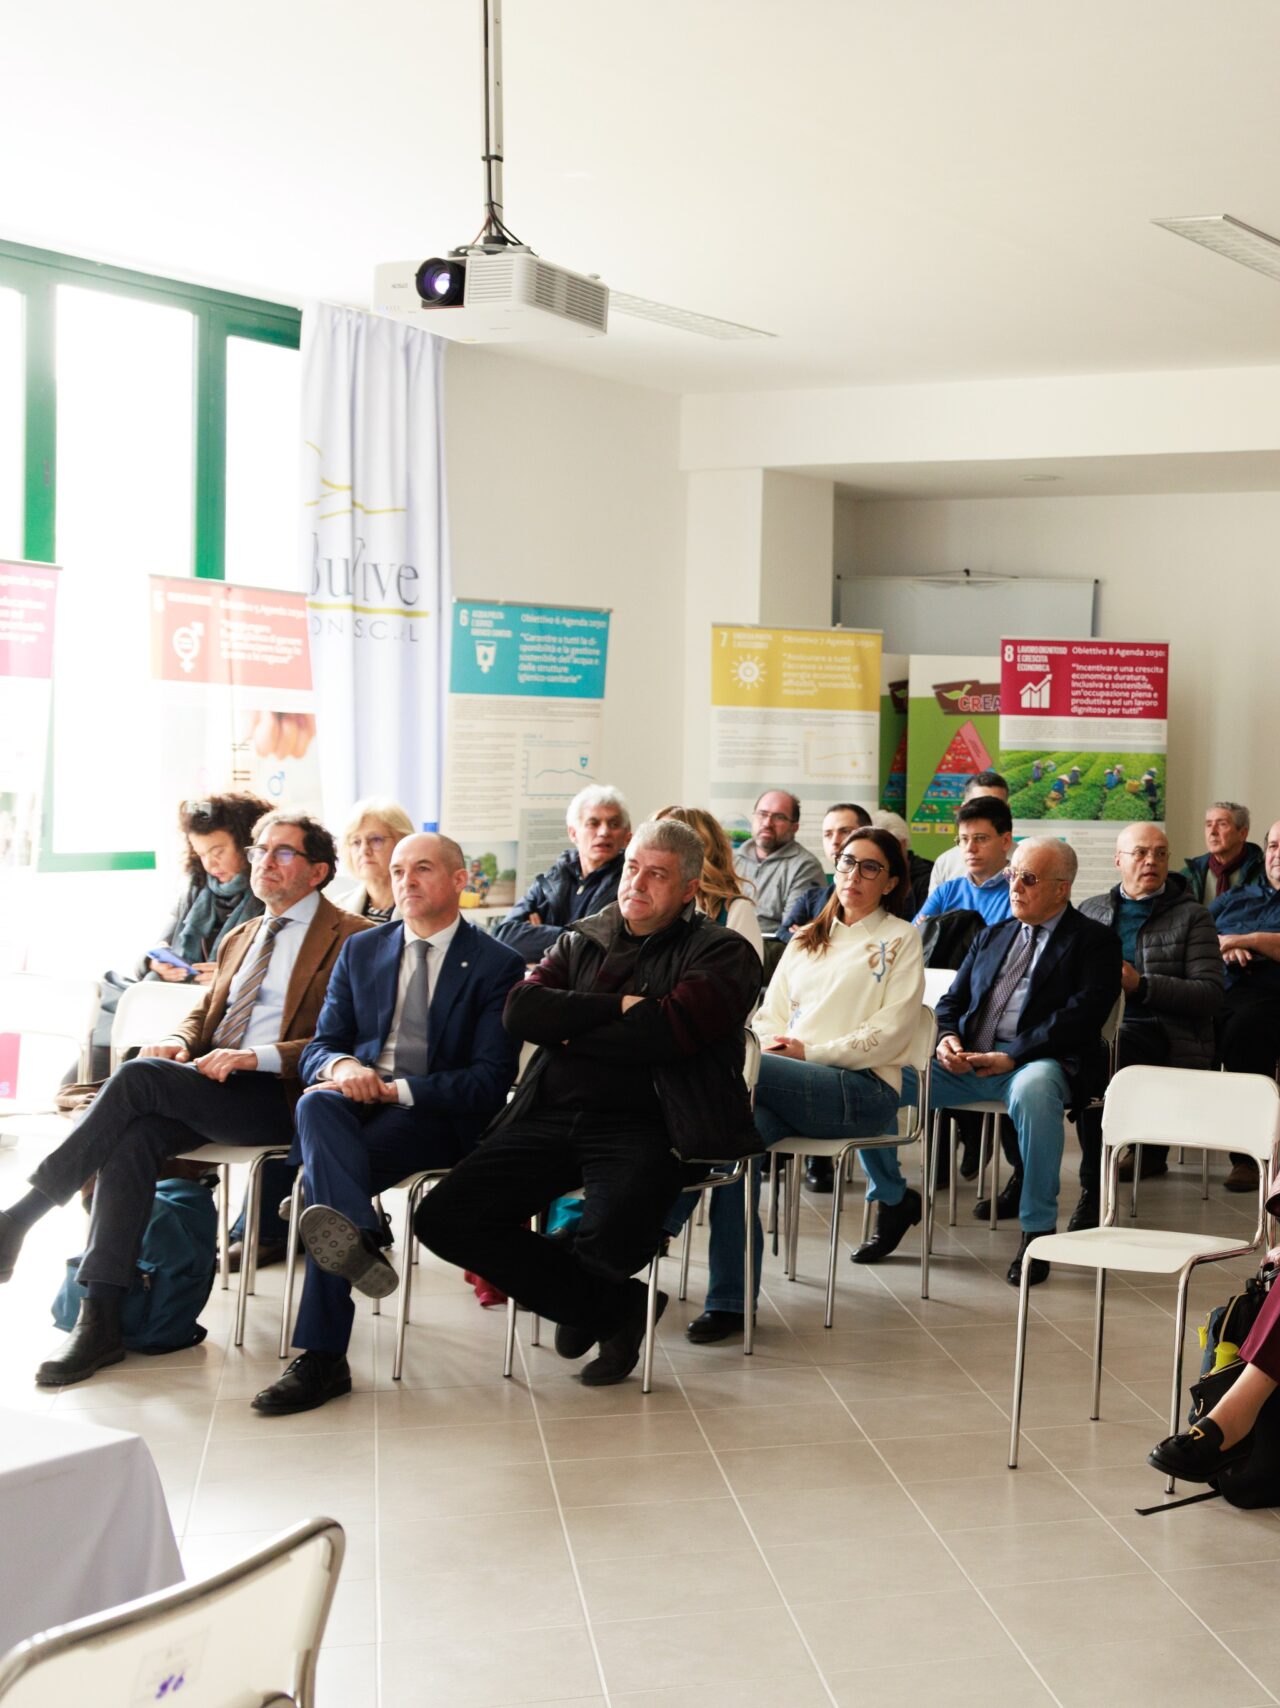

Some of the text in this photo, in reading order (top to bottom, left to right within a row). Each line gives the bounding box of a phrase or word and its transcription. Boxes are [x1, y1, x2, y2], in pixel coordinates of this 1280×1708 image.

[460, 609, 469, 626] 6
[720, 631, 728, 648] 7
[1005, 645, 1014, 662] 8
[1072, 647, 1107, 655] Obiettivo
[1115, 648, 1144, 658] Agenda
[1131, 691, 1152, 699] piena
[1071, 698, 1111, 706] produttiva
[1112, 698, 1122, 706] ed
[1134, 698, 1158, 707] lavoro
[1071, 705, 1106, 715] dignitoso
[1107, 707, 1120, 716] per
